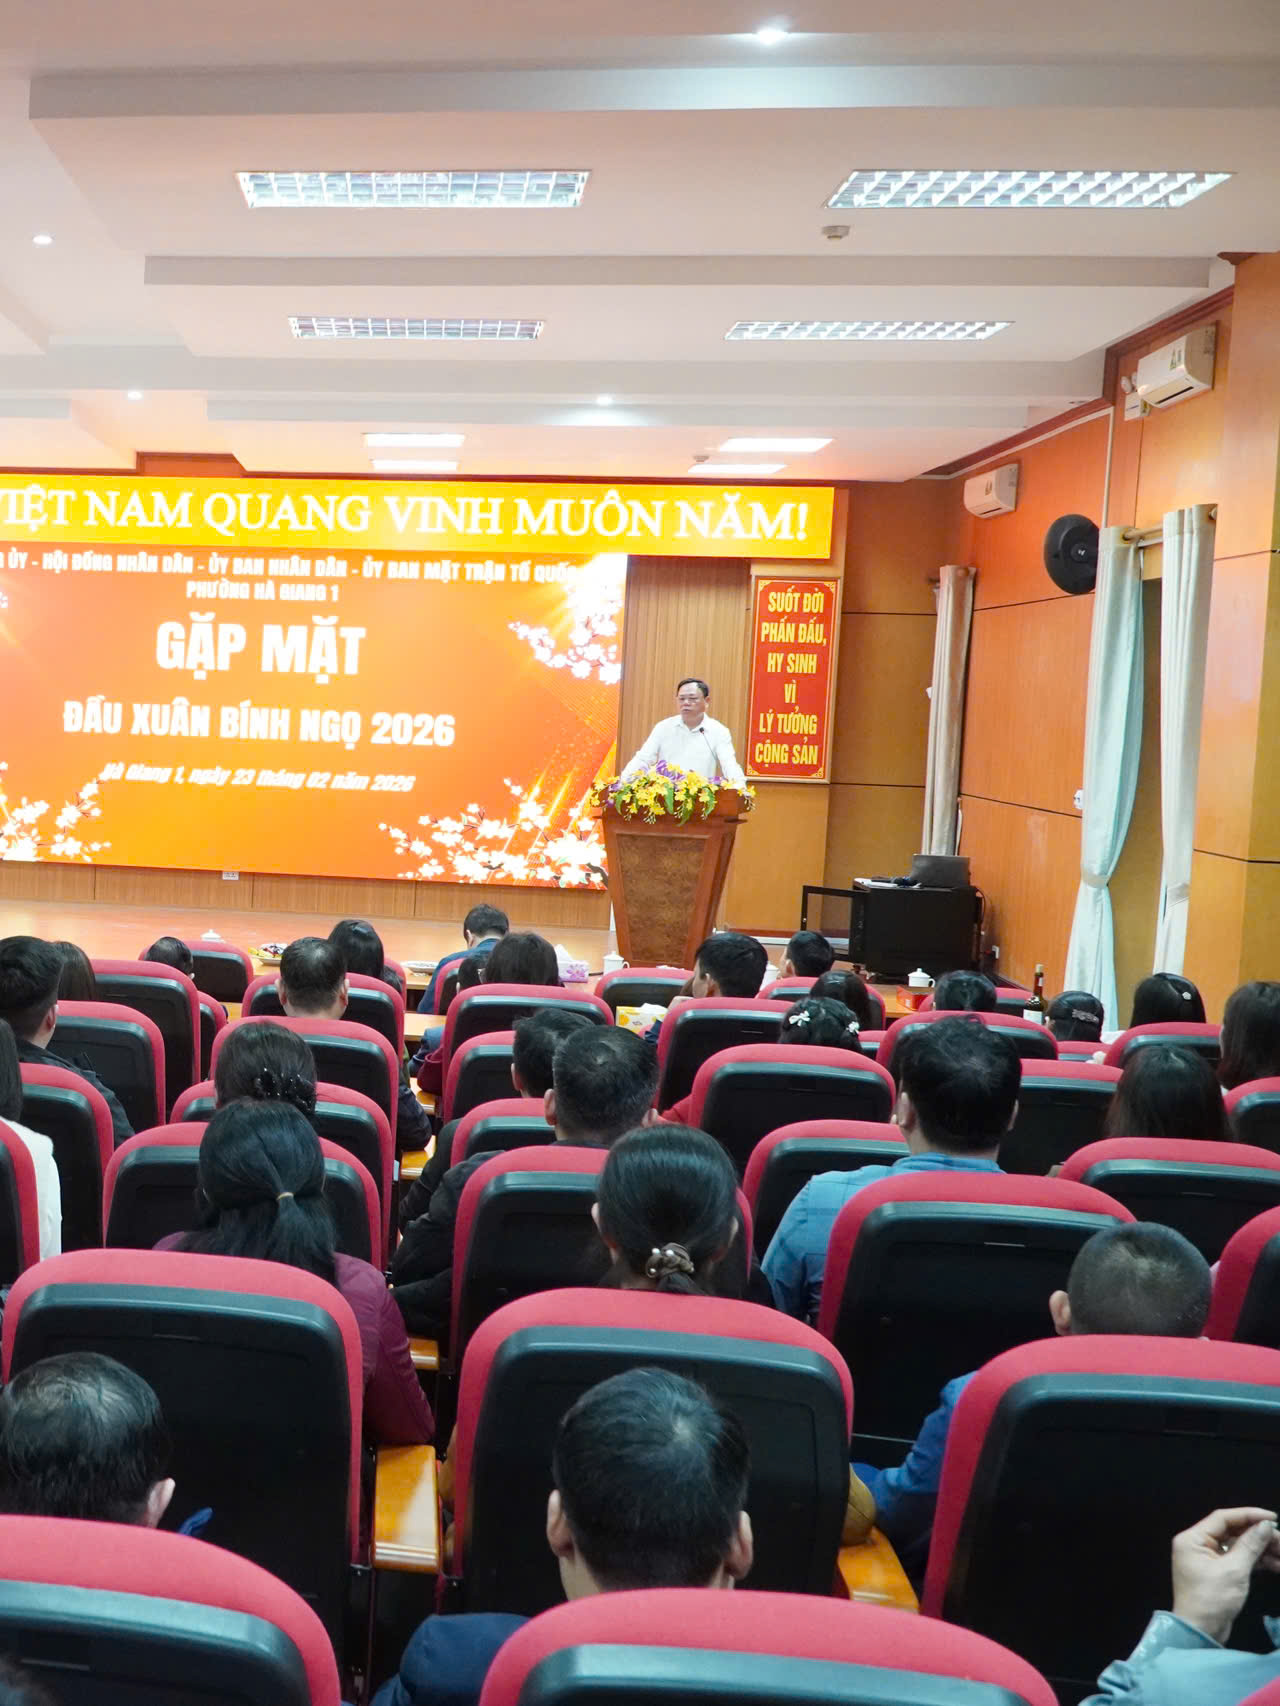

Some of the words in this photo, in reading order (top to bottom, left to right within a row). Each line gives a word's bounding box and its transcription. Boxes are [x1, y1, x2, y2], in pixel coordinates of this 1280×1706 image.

[84, 490, 193, 528] NAM
[203, 494, 372, 536] QUANG
[384, 495, 504, 534] VINH
[514, 489, 666, 537] MUÔN
[675, 492, 808, 541] NĂM!
[8, 546, 28, 569] ỦY
[42, 550, 68, 573] HỘI
[117, 551, 158, 572] NHÂN
[162, 552, 193, 573] DÂN
[209, 551, 228, 574] ỦY
[232, 557, 264, 575] BAN
[268, 555, 311, 576] NHÂN
[315, 555, 347, 577] DÂN
[363, 555, 384, 578] ỦY
[387, 561, 420, 579] BAN
[423, 559, 460, 583] MẶT
[464, 560, 506, 584] TRẬN
[186, 578, 250, 599] PHƯỜNG
[254, 579, 275, 600] HÀ
[280, 583, 326, 601] GIANG
[331, 584, 339, 602] 1
[768, 585, 800, 613] SUỐT
[802, 587, 824, 613] ĐỜI
[761, 615, 795, 643] PHẤN
[798, 616, 827, 646] ĐẤU,
[155, 611, 246, 680] GẶP
[260, 615, 367, 684] MẶT
[767, 652, 784, 672] HY
[786, 653, 817, 674] SINH
[784, 679, 796, 703] VÌ
[63, 694, 122, 733] ĐẦU
[130, 696, 210, 737] XUÂN
[220, 699, 290, 740] BÍNH
[299, 709, 361, 750] NGỌ
[370, 712, 456, 747] 2026
[759, 709, 774, 733] LÝ
[777, 705, 817, 735] TƯỞNG
[755, 739, 789, 767] CỘNG
[791, 736, 818, 765] SẢN
[125, 763, 173, 784] Giang
[188, 765, 231, 786] ngày
[231, 768, 256, 785] 23
[256, 769, 306, 789] tháng
[307, 772, 331, 788] 02
[331, 772, 370, 790] năm
[370, 775, 416, 792] 2026
